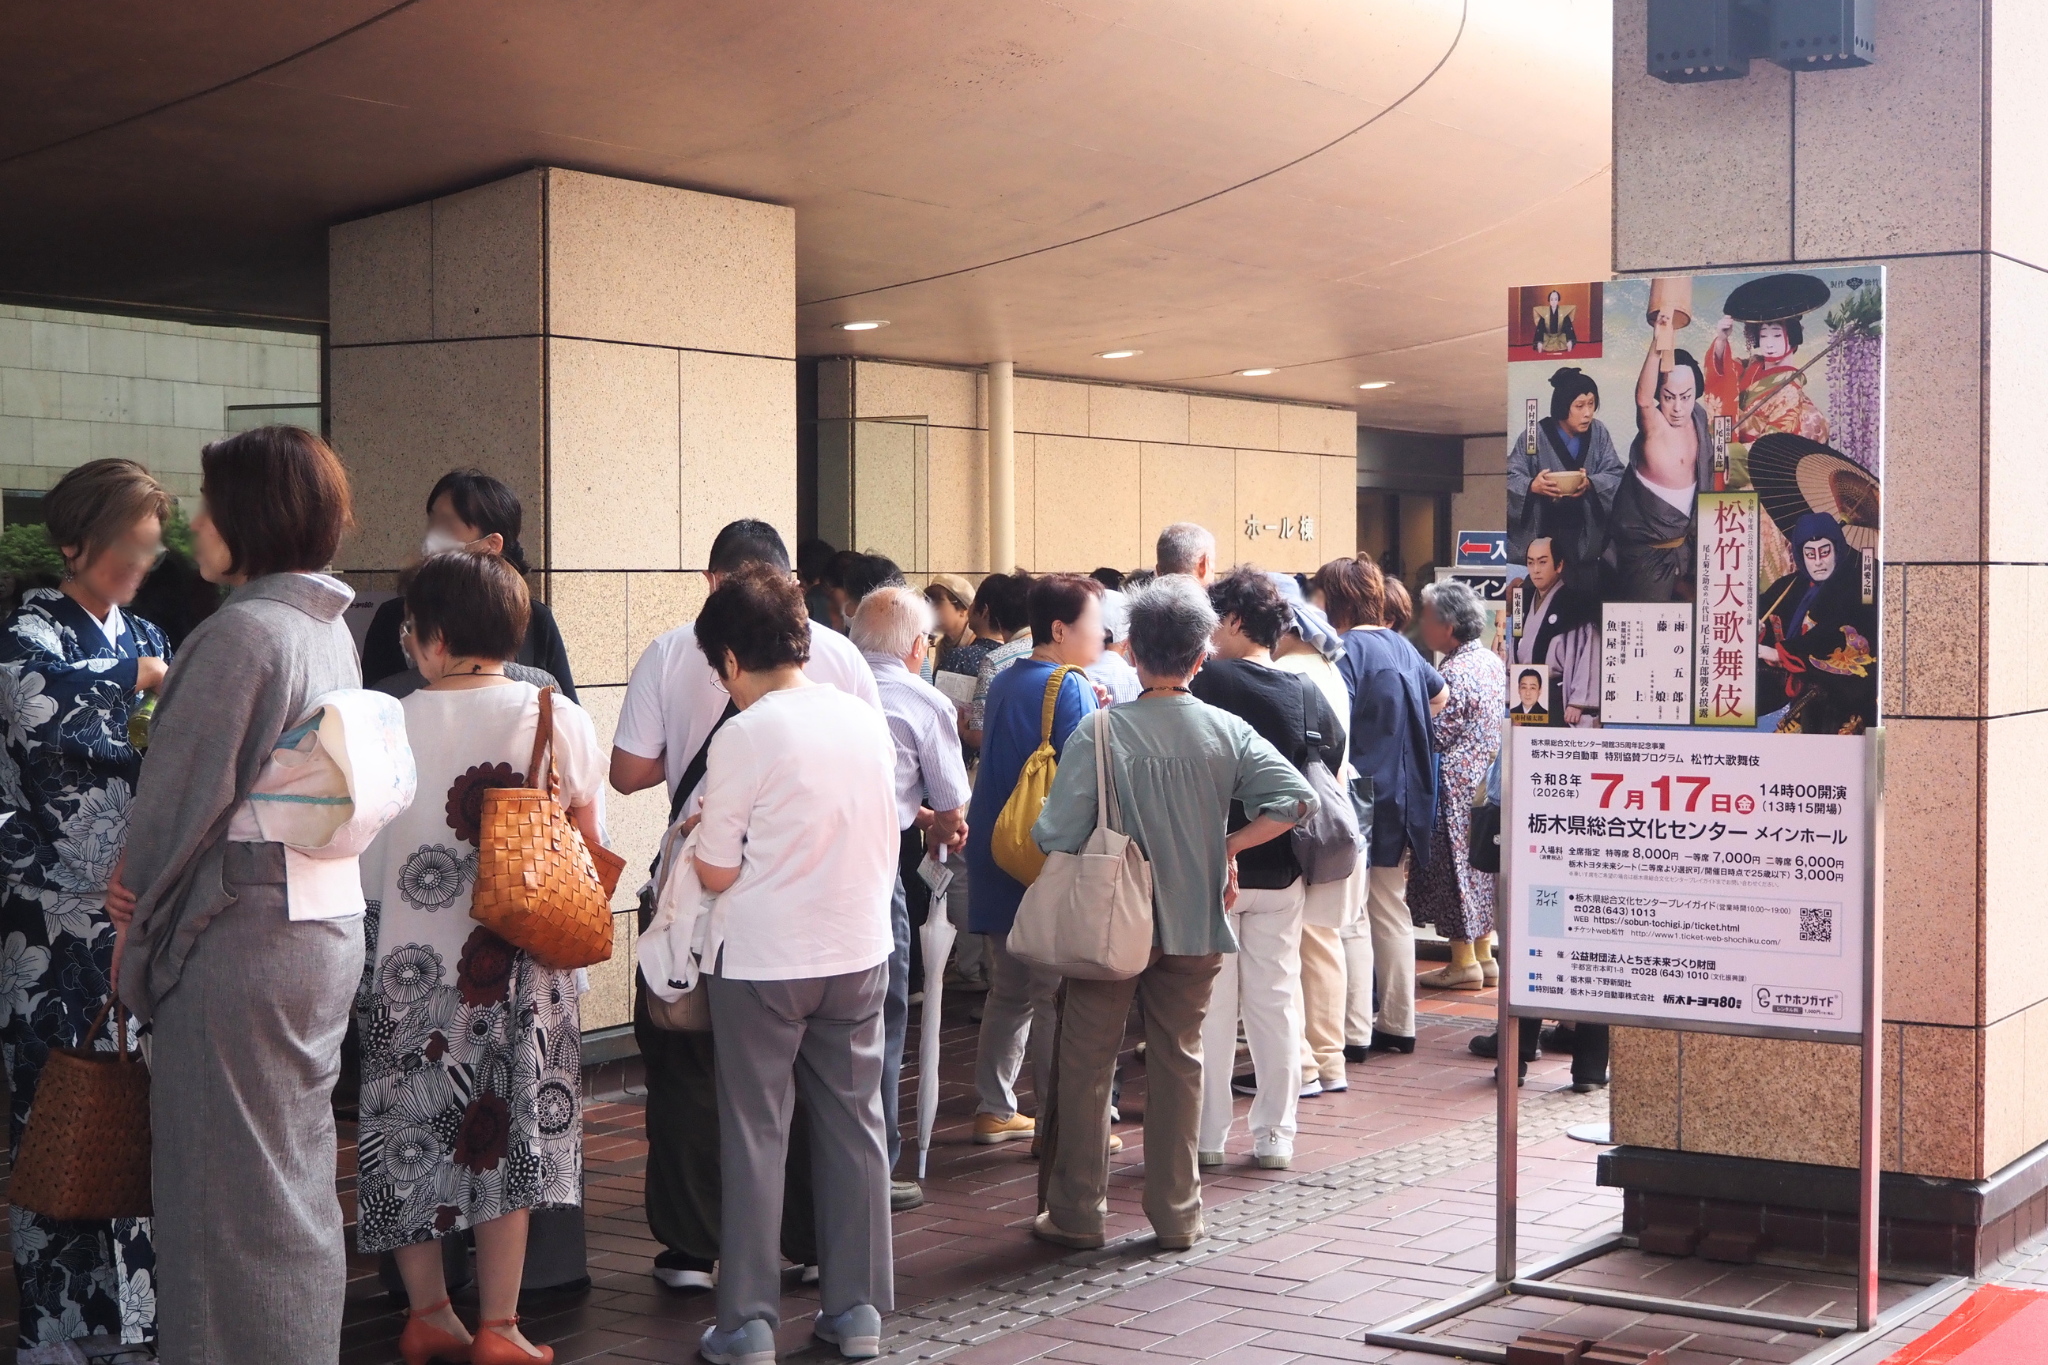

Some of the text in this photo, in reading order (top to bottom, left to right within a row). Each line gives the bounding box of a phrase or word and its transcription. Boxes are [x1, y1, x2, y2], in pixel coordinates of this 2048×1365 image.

[1711, 499, 1745, 718] 松竹大歌舞伎
[1531, 749, 1760, 767] 栃木トヨタ自動車 特別協賛プログラム 松竹大歌舞伎
[1530, 772, 1582, 787] 令和8年
[1532, 787, 1580, 799] (2026年)
[1759, 783, 1847, 800] 14時00開演
[1762, 801, 1843, 815] (13時15開場)
[1527, 813, 1848, 845] 栃木県総合文化センター メインホール
[1539, 845, 1844, 869] 入場料 全席指定 特等席 8,000円 一等席 7,000円 二等席 6,000円
[1794, 868, 1844, 882] 3,000円
[1536, 889, 1558, 899] プレイ
[1536, 898, 1558, 907] ガイド
[1573, 915, 1589, 923] WEB
[1775, 993, 1834, 1007] イヤホンガイド
